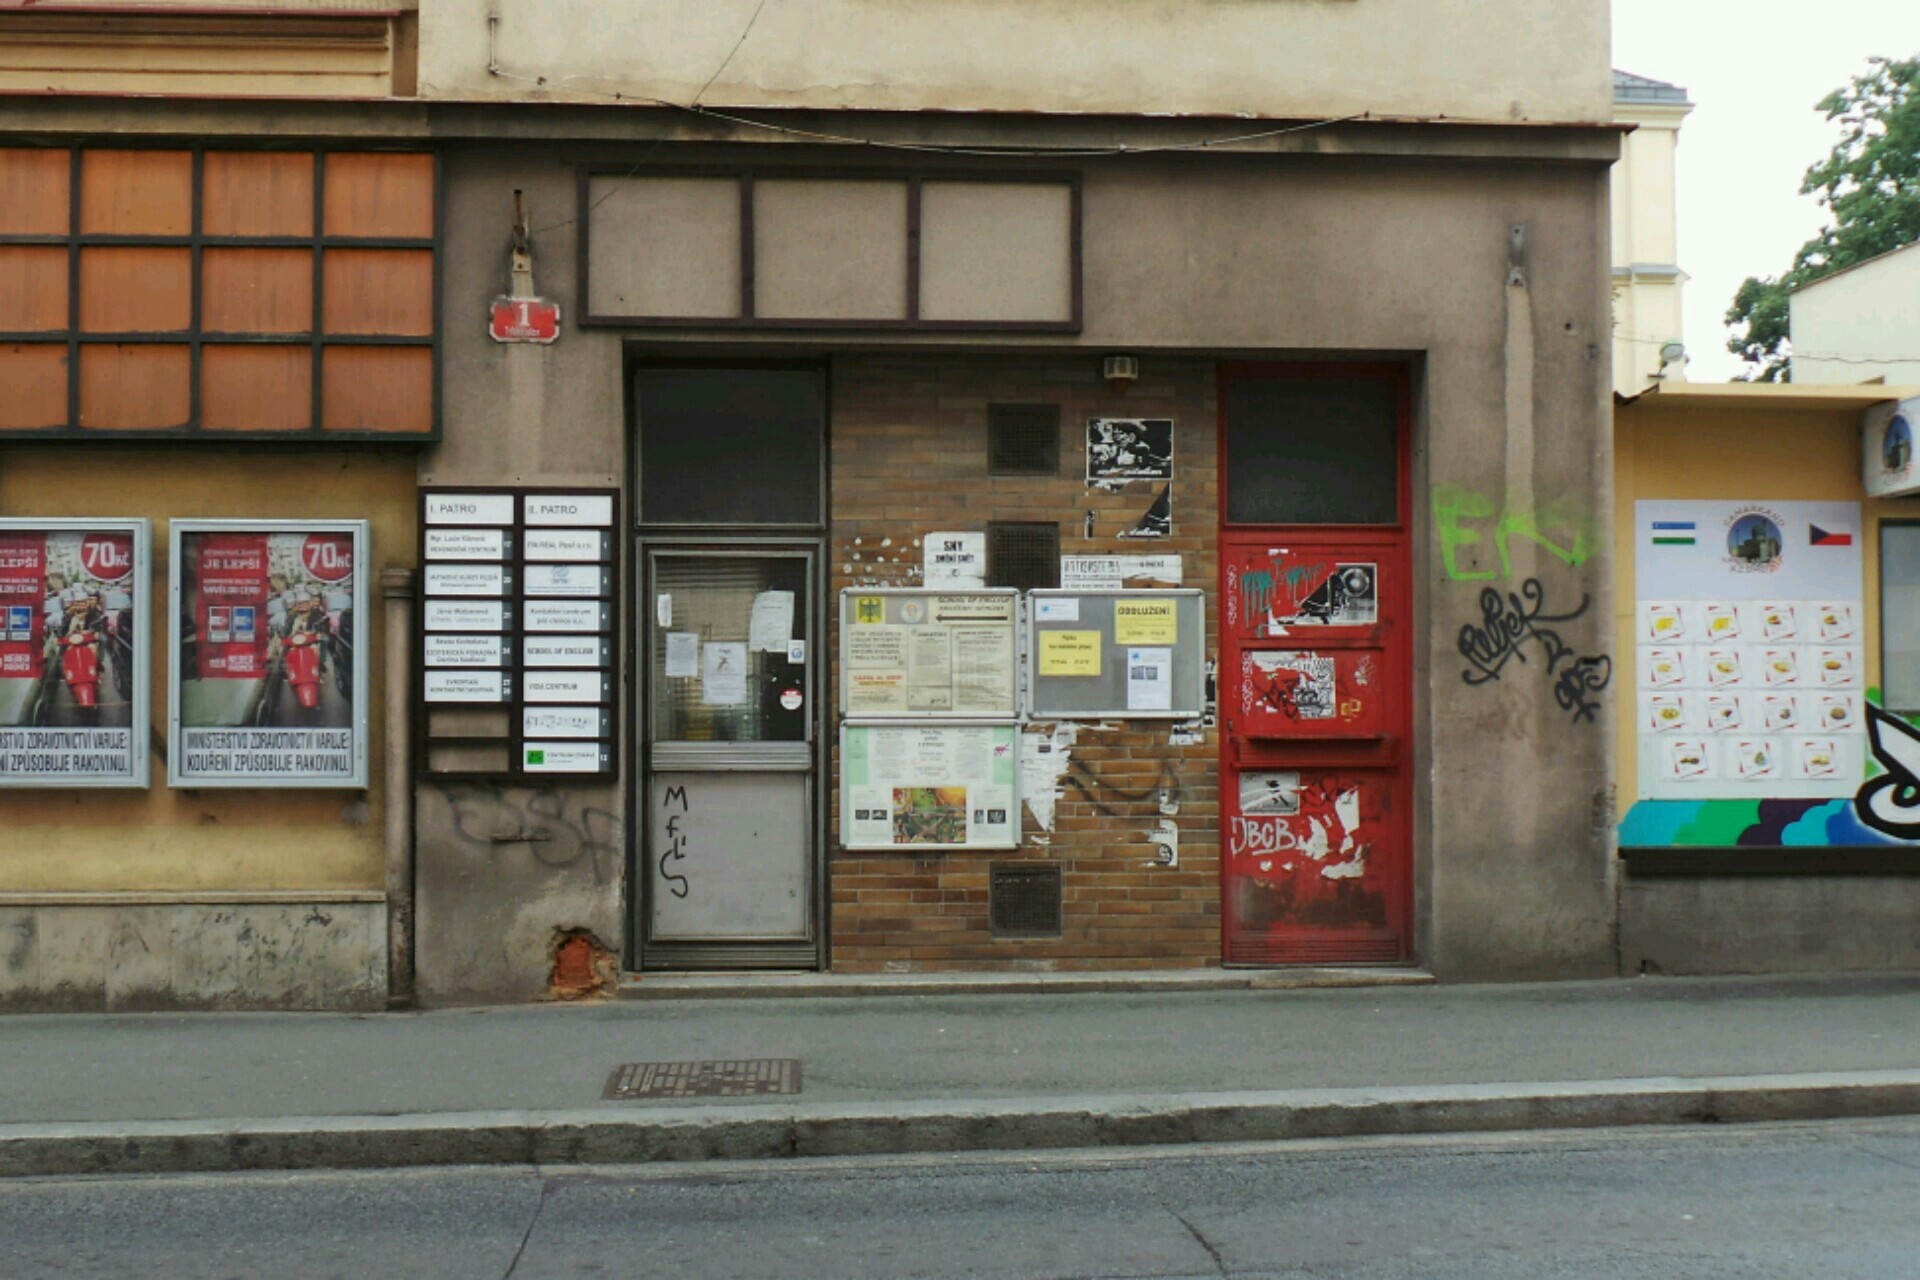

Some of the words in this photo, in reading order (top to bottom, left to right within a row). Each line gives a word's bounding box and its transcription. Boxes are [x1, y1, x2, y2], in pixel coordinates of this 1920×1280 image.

[519, 303, 530, 327] 1
[440, 504, 477, 514] PATRO
[540, 505, 578, 515] PATRO
[223, 557, 260, 569] LEPŠÍ
[527, 647, 553, 655] SCHOOL
[554, 647, 563, 655] OF
[564, 647, 594, 655] ENGLISH
[545, 682, 578, 691] CENTRUM
[27, 730, 92, 750] ZDRAVOTNICTVÍ
[186, 731, 248, 750] MINISTERSTVO
[250, 730, 314, 750] ZDRAVOTNICTVÍ
[11, 751, 71, 772] ZPŮSOBUJE
[73, 753, 127, 772] RAKOVINU.
[186, 751, 232, 772] KOUŘENÍ
[234, 751, 293, 772] ZPŮSOBUJE
[295, 753, 348, 772] RAKOVINU.
